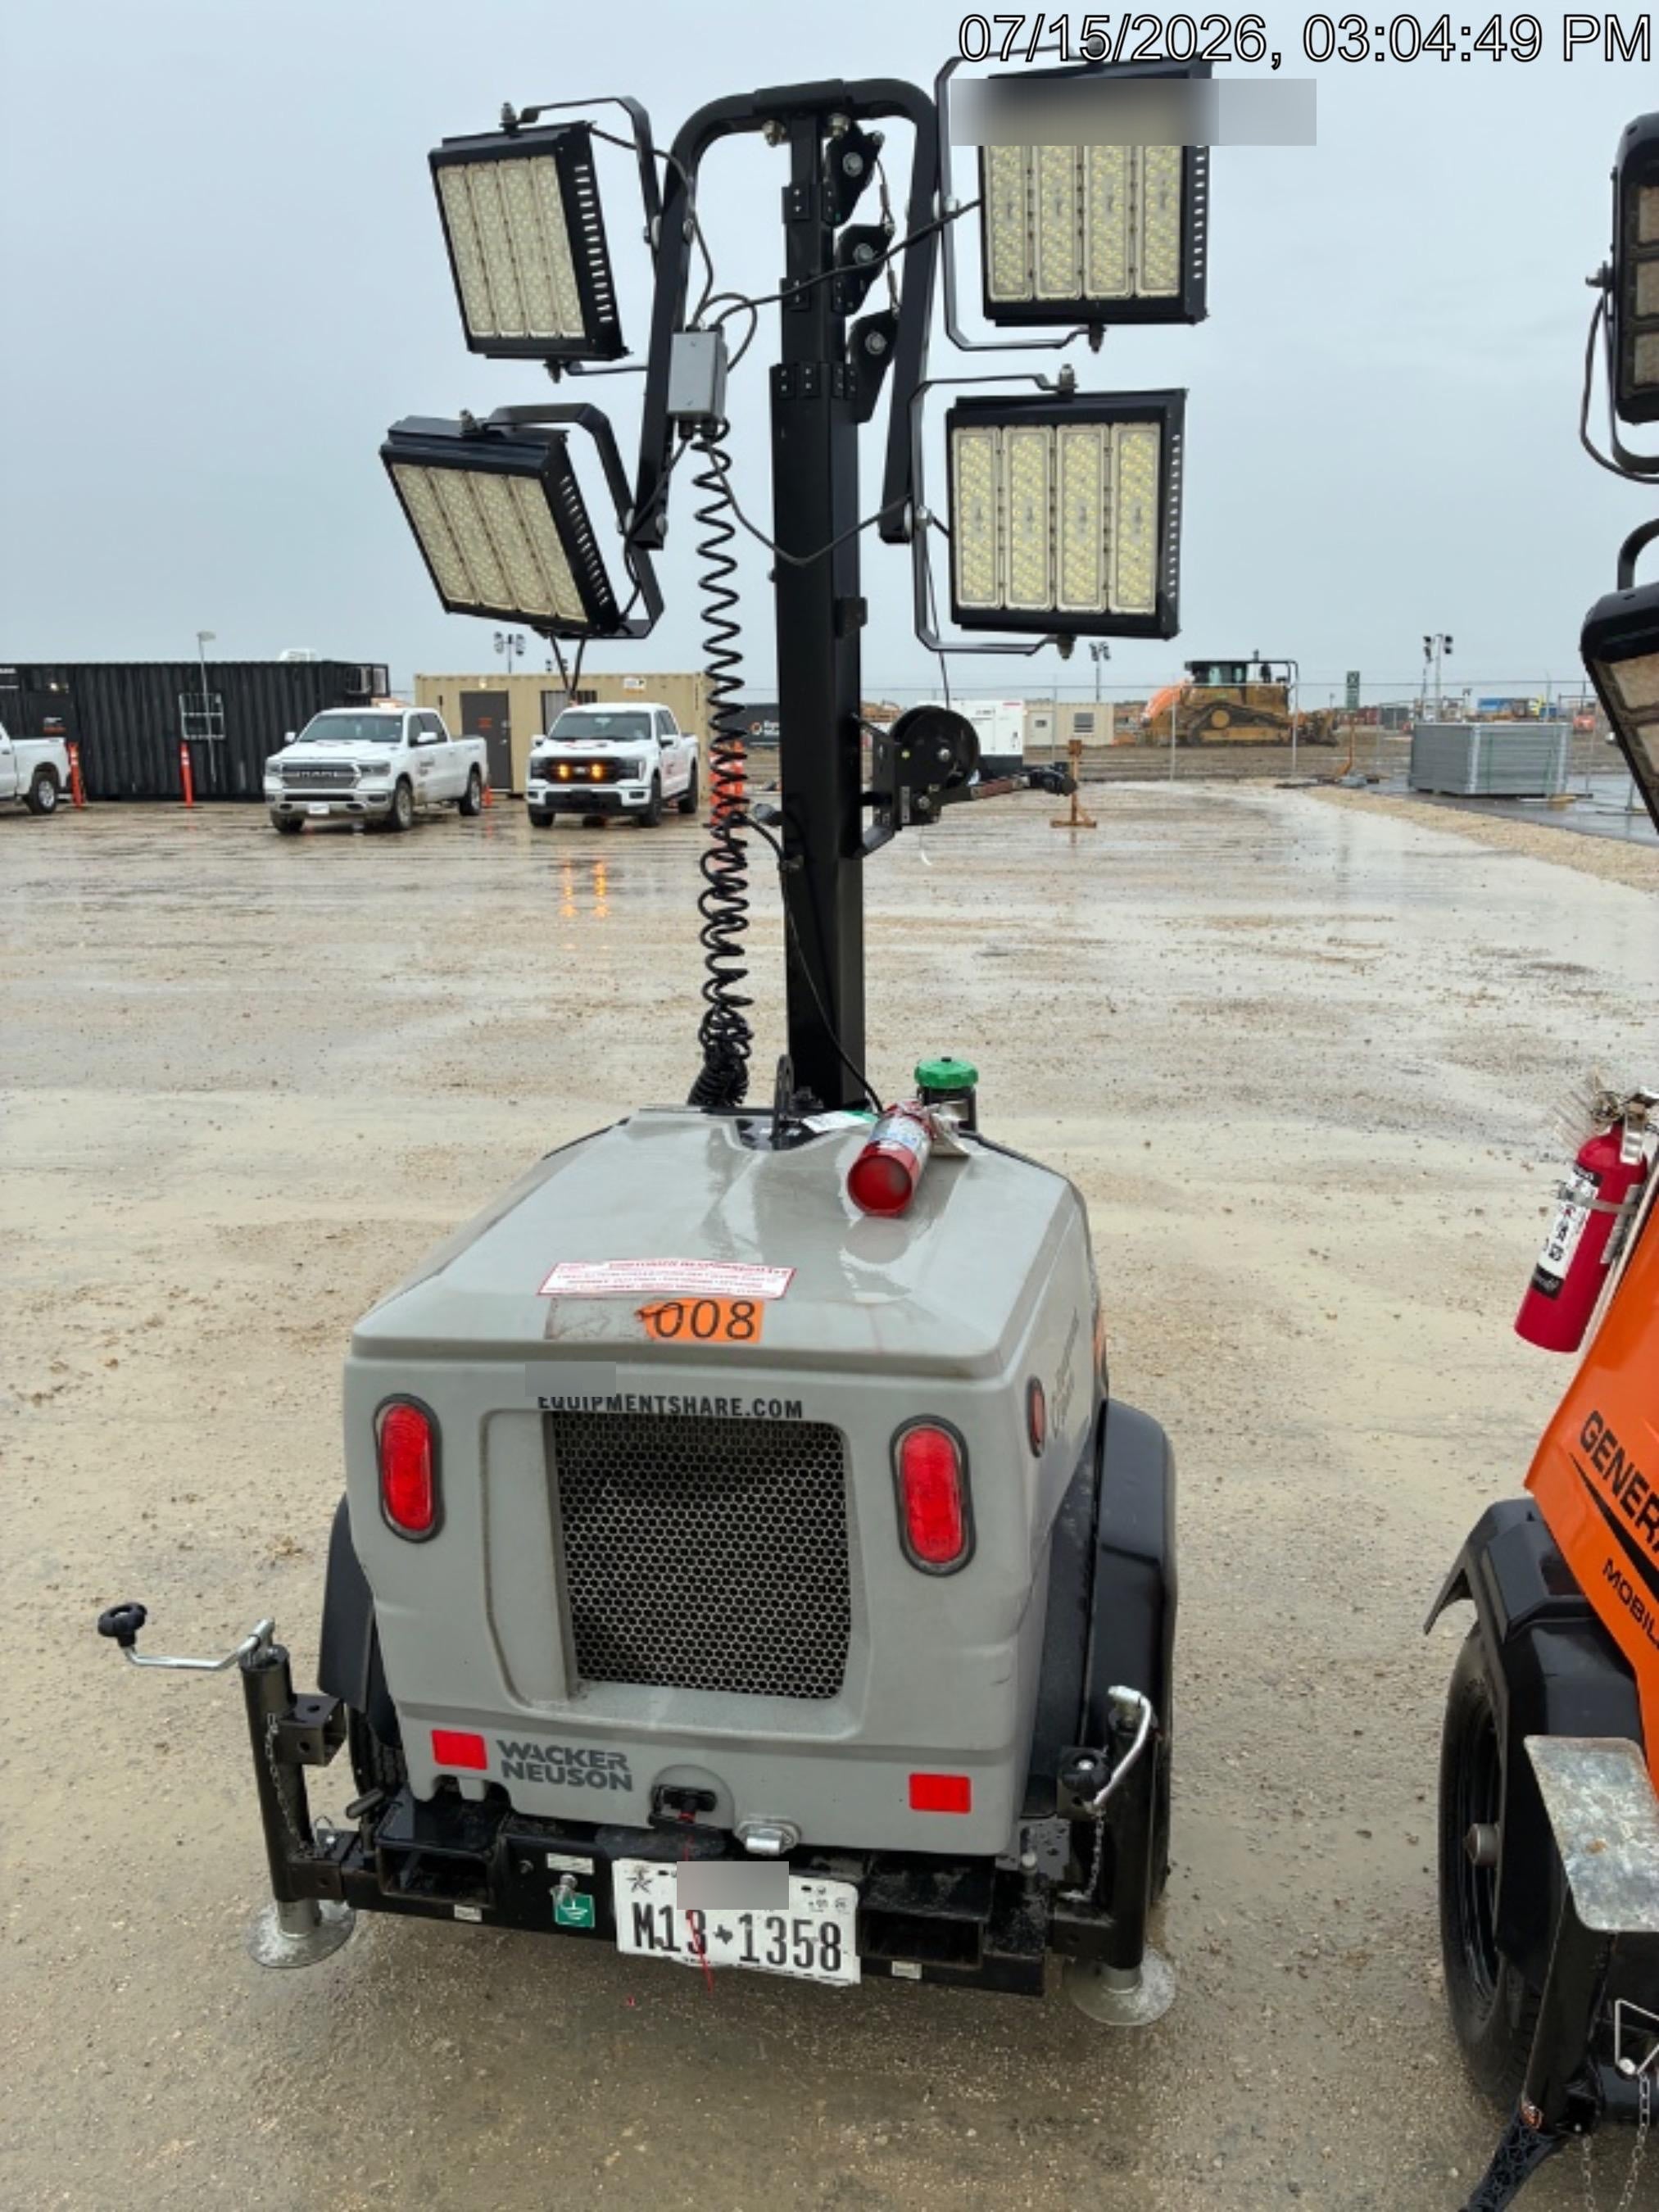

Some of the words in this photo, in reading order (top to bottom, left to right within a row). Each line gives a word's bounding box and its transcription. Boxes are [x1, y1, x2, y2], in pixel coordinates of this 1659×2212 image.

[655, 1299, 755, 1339] 008
[1580, 1410, 1659, 1553] GENER
[1602, 1557, 1659, 1650] MOBIL
[496, 1740, 629, 1771] WACKER
[501, 1759, 632, 1792] NEUSON
